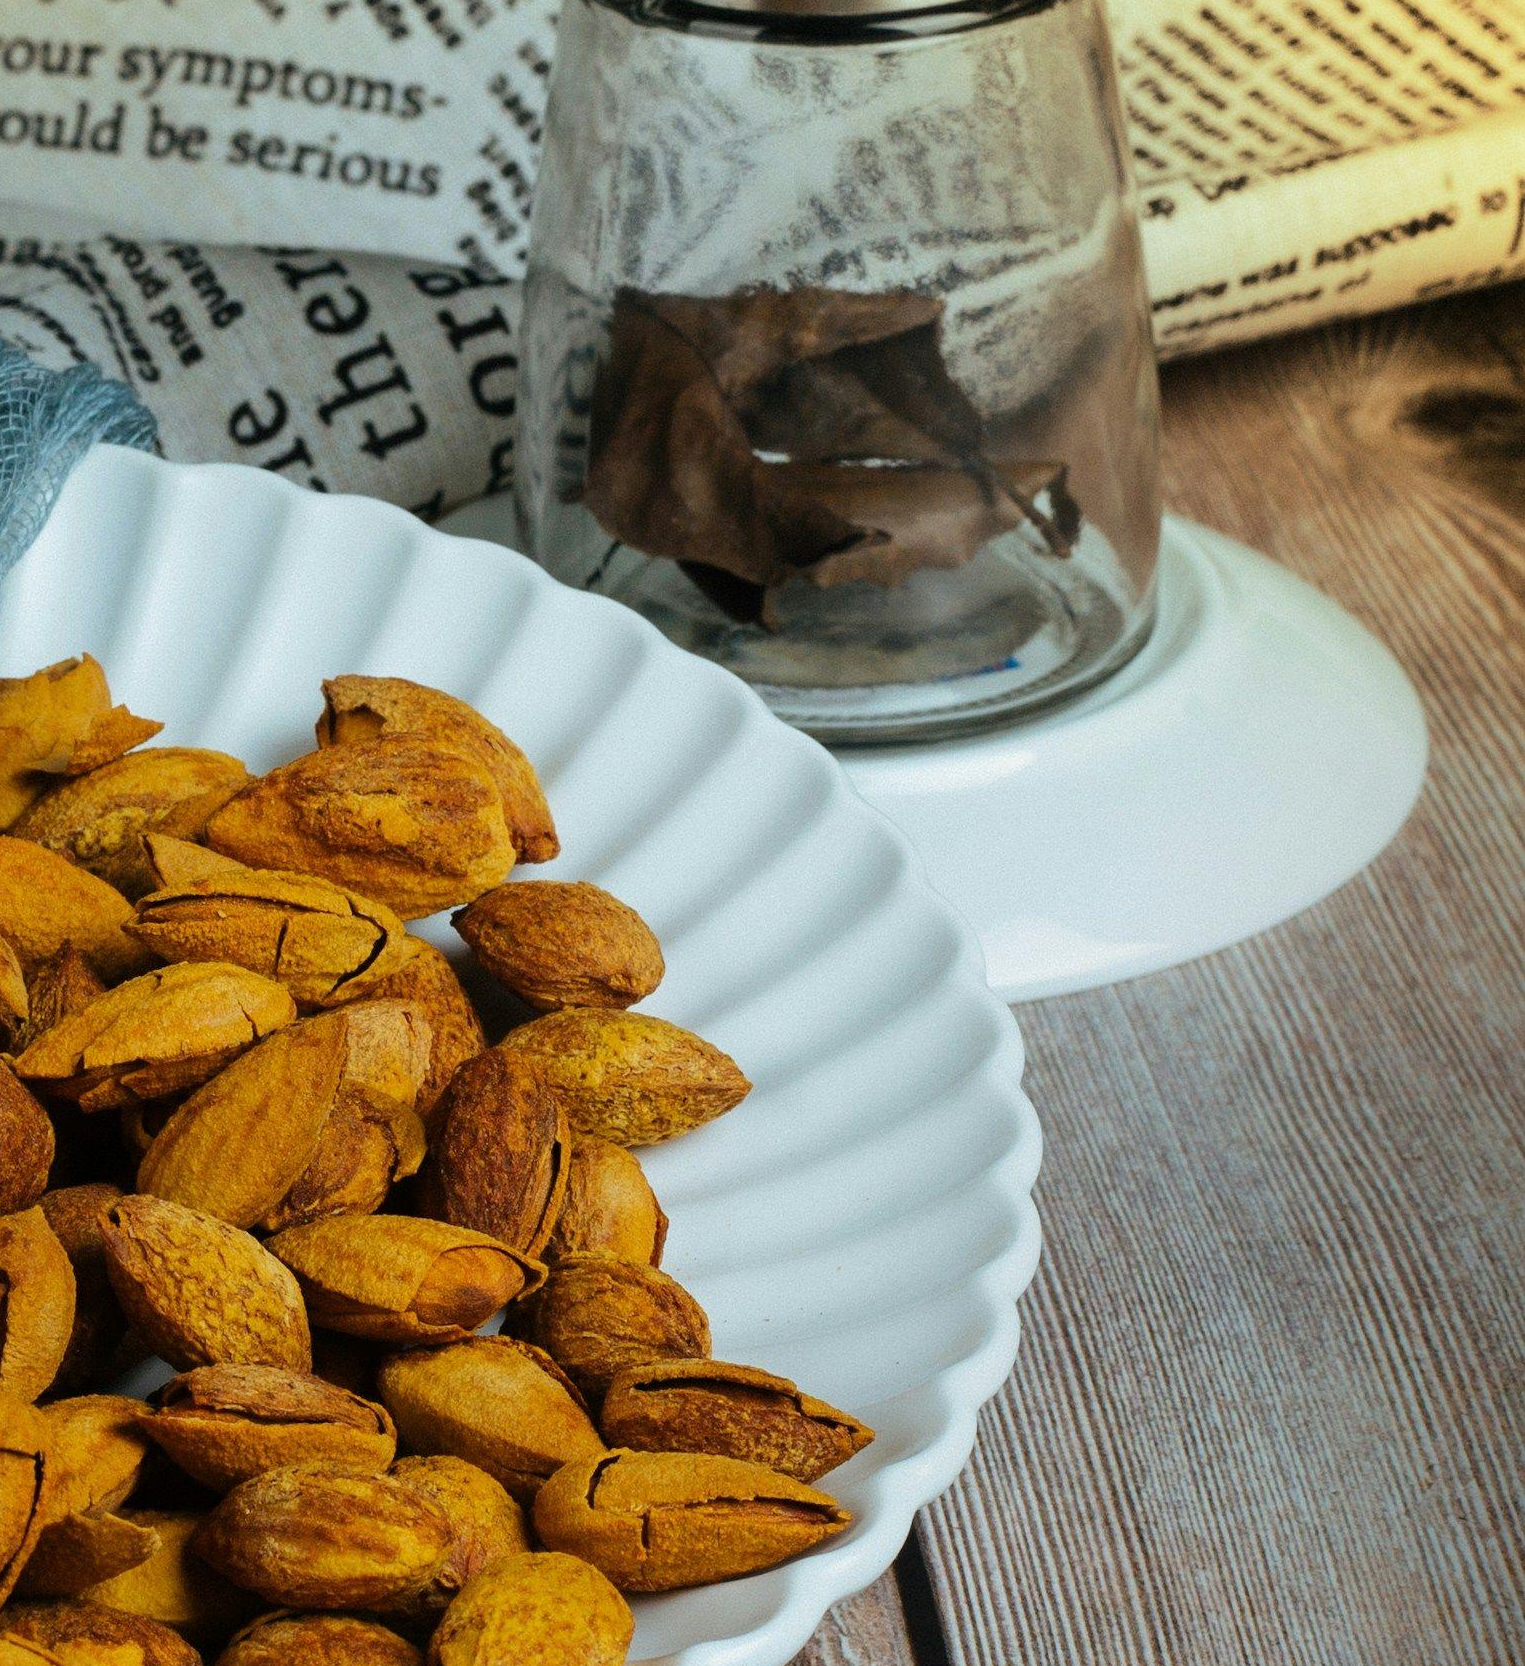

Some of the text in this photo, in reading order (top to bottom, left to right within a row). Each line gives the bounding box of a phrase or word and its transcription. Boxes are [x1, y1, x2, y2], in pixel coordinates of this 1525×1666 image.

[118, 37, 449, 121] symptoms-
[145, 113, 208, 163] be
[226, 131, 443, 199] serious
[145, 301, 207, 372] and
[262, 246, 429, 460] ther
